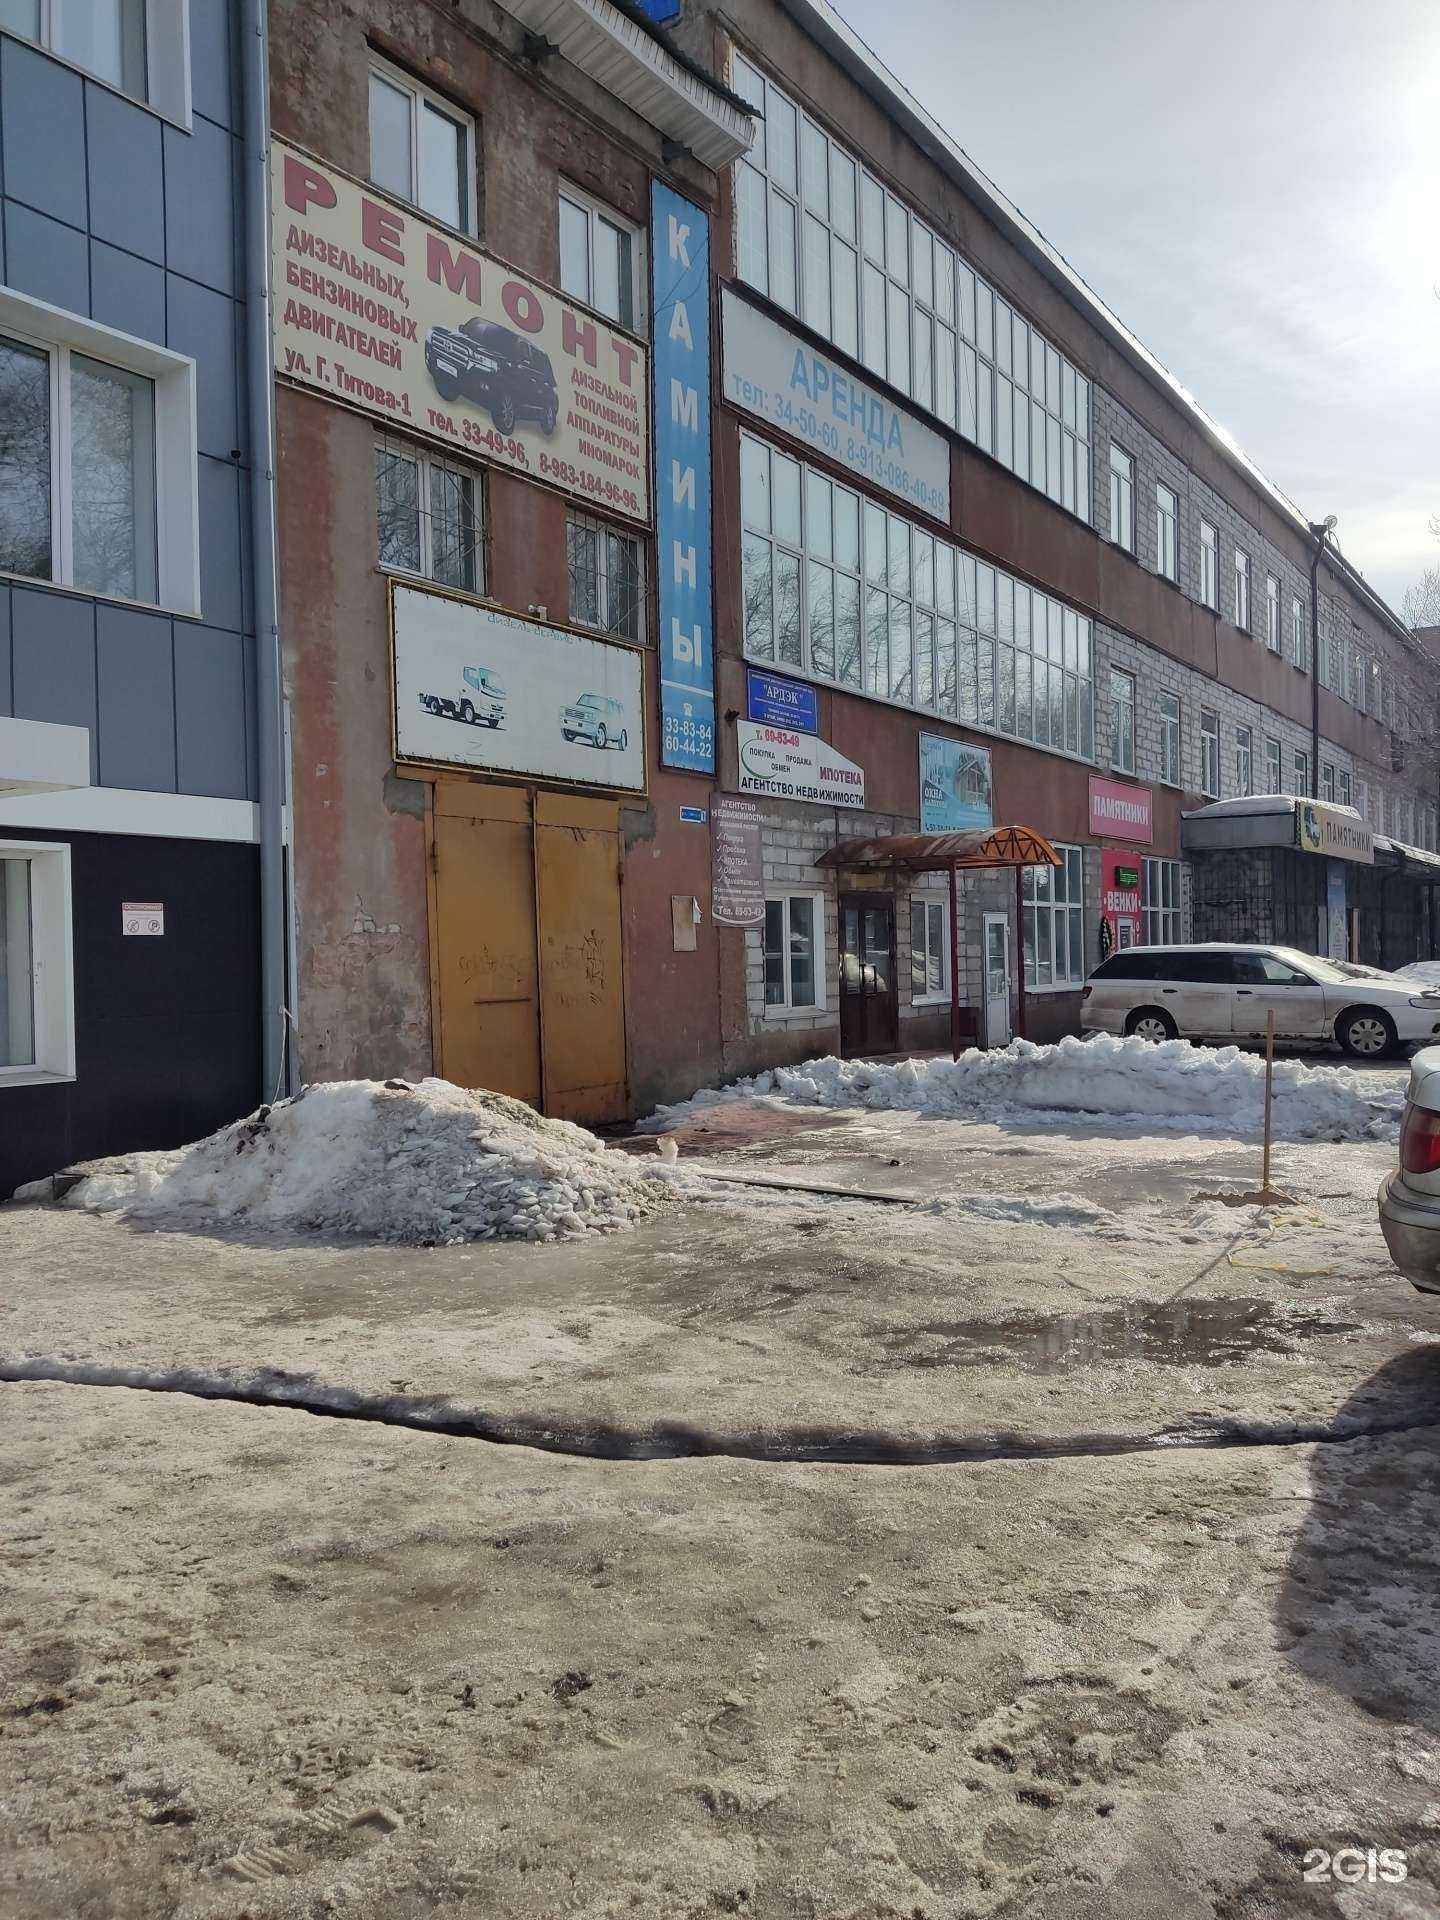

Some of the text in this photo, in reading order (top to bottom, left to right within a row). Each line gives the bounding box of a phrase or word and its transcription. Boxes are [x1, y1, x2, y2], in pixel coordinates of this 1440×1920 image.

[284, 154, 638, 387] РЕМОНТ
[286, 224, 410, 309] ДИЗЕЛЬНЫХ,
[286, 259, 418, 343] БЕНЗИНОВЫХ
[283, 298, 403, 371] ДВИГАТЕЛЕЙ
[285, 347, 412, 417] ул. Г. Титова-1
[570, 367, 638, 413] ДИЗЕЛЬНОЙ
[789, 349, 905, 458] АРЕНДА
[566, 410, 640, 458] АППАРАТУРЫ
[574, 390, 640, 436] ТОПЛИВНОЙ
[427, 408, 458, 436] тел.
[462, 418, 530, 470] 33-49-96,
[578, 438, 641, 480] ИНОМАРОК
[668, 213, 703, 669] КАМИНЫ
[665, 716, 712, 741] 33-83-84
[665, 735, 712, 758] 60-44-22
[749, 747, 812, 767] ПОКУПКА ПРОДАЖА
[770, 762, 791, 774] ОБМЕН
[819, 766, 862, 786] ИПОТЕКА
[741, 776, 865, 806] АГЕНТСТВО НЕДВИЖИМОСТИ
[924, 787, 943, 800] ОКНА
[1093, 795, 1149, 825] ПАМЯТНИКИ
[1326, 821, 1371, 852] ПАМЯТНИКИ
[1107, 890, 1138, 913] ВЕНКИ
